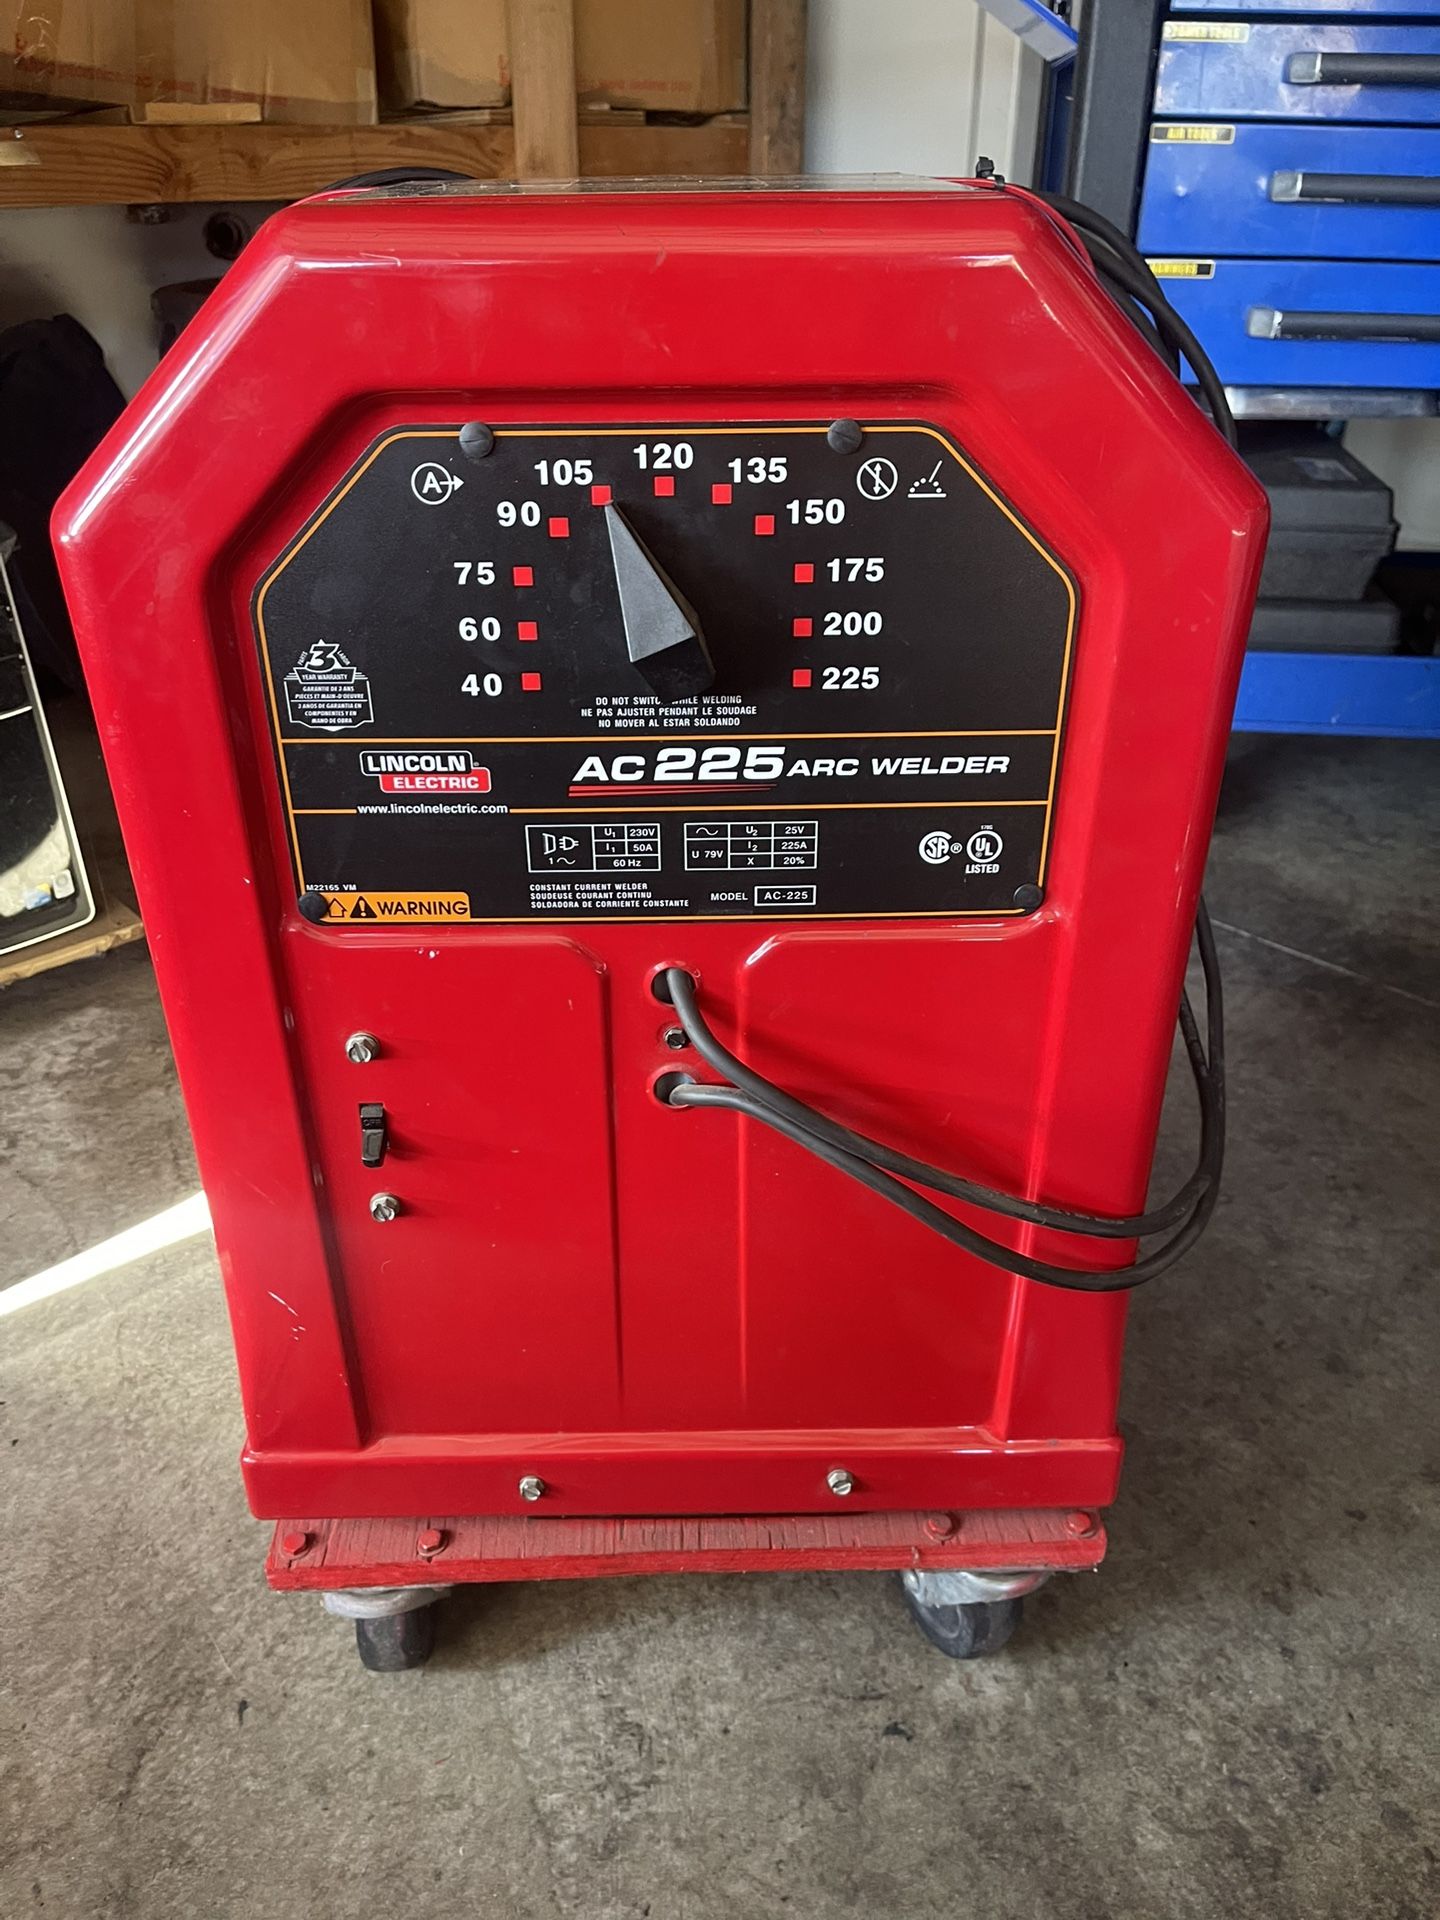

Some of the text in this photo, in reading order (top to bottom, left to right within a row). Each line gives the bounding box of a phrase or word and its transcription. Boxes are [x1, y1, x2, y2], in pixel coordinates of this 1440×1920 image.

[633, 443, 693, 470] 120
[534, 460, 593, 486] 105
[728, 457, 788, 484] 135
[496, 501, 541, 527] 90
[786, 499, 845, 524] 150
[453, 562, 496, 585] 75
[827, 557, 885, 582] 175
[459, 617, 501, 641] 60
[824, 612, 882, 636] 200
[306, 644, 338, 672] 3
[461, 673, 502, 696] 40
[822, 667, 880, 690] 225
[596, 697, 608, 705] DO
[612, 697, 629, 705] NOT
[702, 695, 742, 704] WELDING
[581, 706, 757, 717] NE PAS AJUSTER PENDANT LE SOUDAGE
[599, 717, 740, 728] NO MOVER AL ESTAR SOLDANDO
[367, 755, 466, 772] LINCOLN
[572, 746, 1010, 782] AC 225 ARC WELDER
[393, 777, 479, 789] ELECTRIC
[357, 803, 508, 814] www.lincolnelectric.com
[629, 828, 655, 837] 230V
[785, 826, 804, 834] 25V
[633, 844, 653, 852] 50A
[782, 841, 807, 850] 225A
[976, 838, 993, 856] UL
[705, 850, 723, 858] 79V
[628, 859, 641, 867] Hz
[965, 864, 999, 874] LISTED
[710, 892, 748, 901] MODEL
[764, 892, 808, 900] AC-225
[377, 901, 468, 915] WARNING
